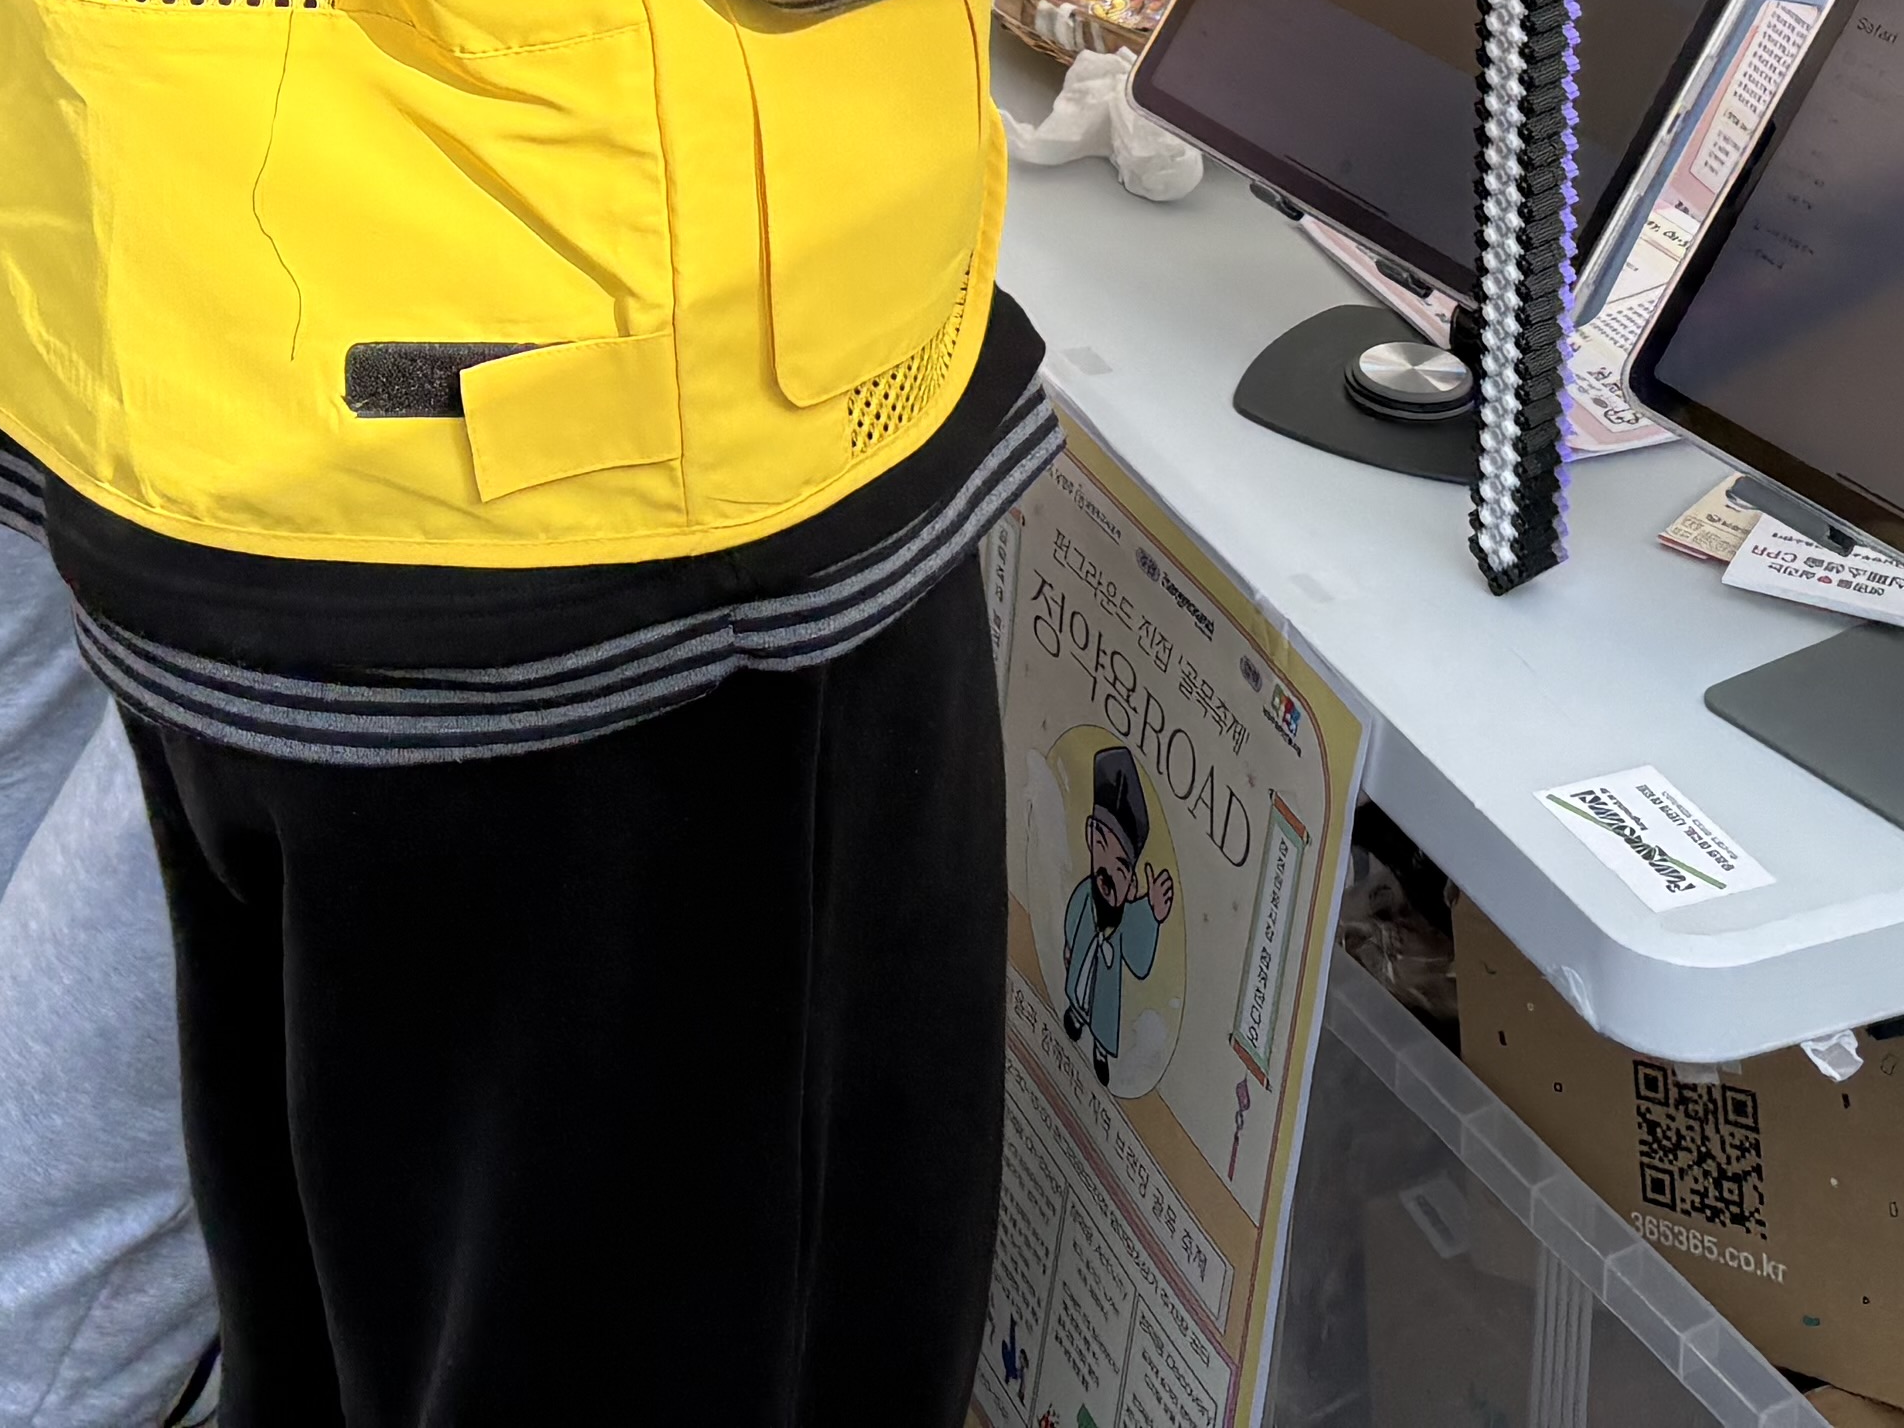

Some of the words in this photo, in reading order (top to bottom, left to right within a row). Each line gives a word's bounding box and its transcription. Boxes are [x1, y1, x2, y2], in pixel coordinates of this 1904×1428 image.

[1054, 528, 1134, 633] 펀그라운드
[1137, 616, 1175, 674] 진접
[1751, 544, 1798, 564] CPR
[1030, 568, 1252, 866] 정약용ROAD
[1041, 1018, 1085, 1104] 함께하는
[1087, 1094, 1112, 1142] 지역
[1115, 1130, 1150, 1200] 브랜딩
[1151, 1191, 1178, 1241] 골목
[1180, 1227, 1210, 1284] 축제
[1630, 1211, 1788, 1284] 365365.co.kr
